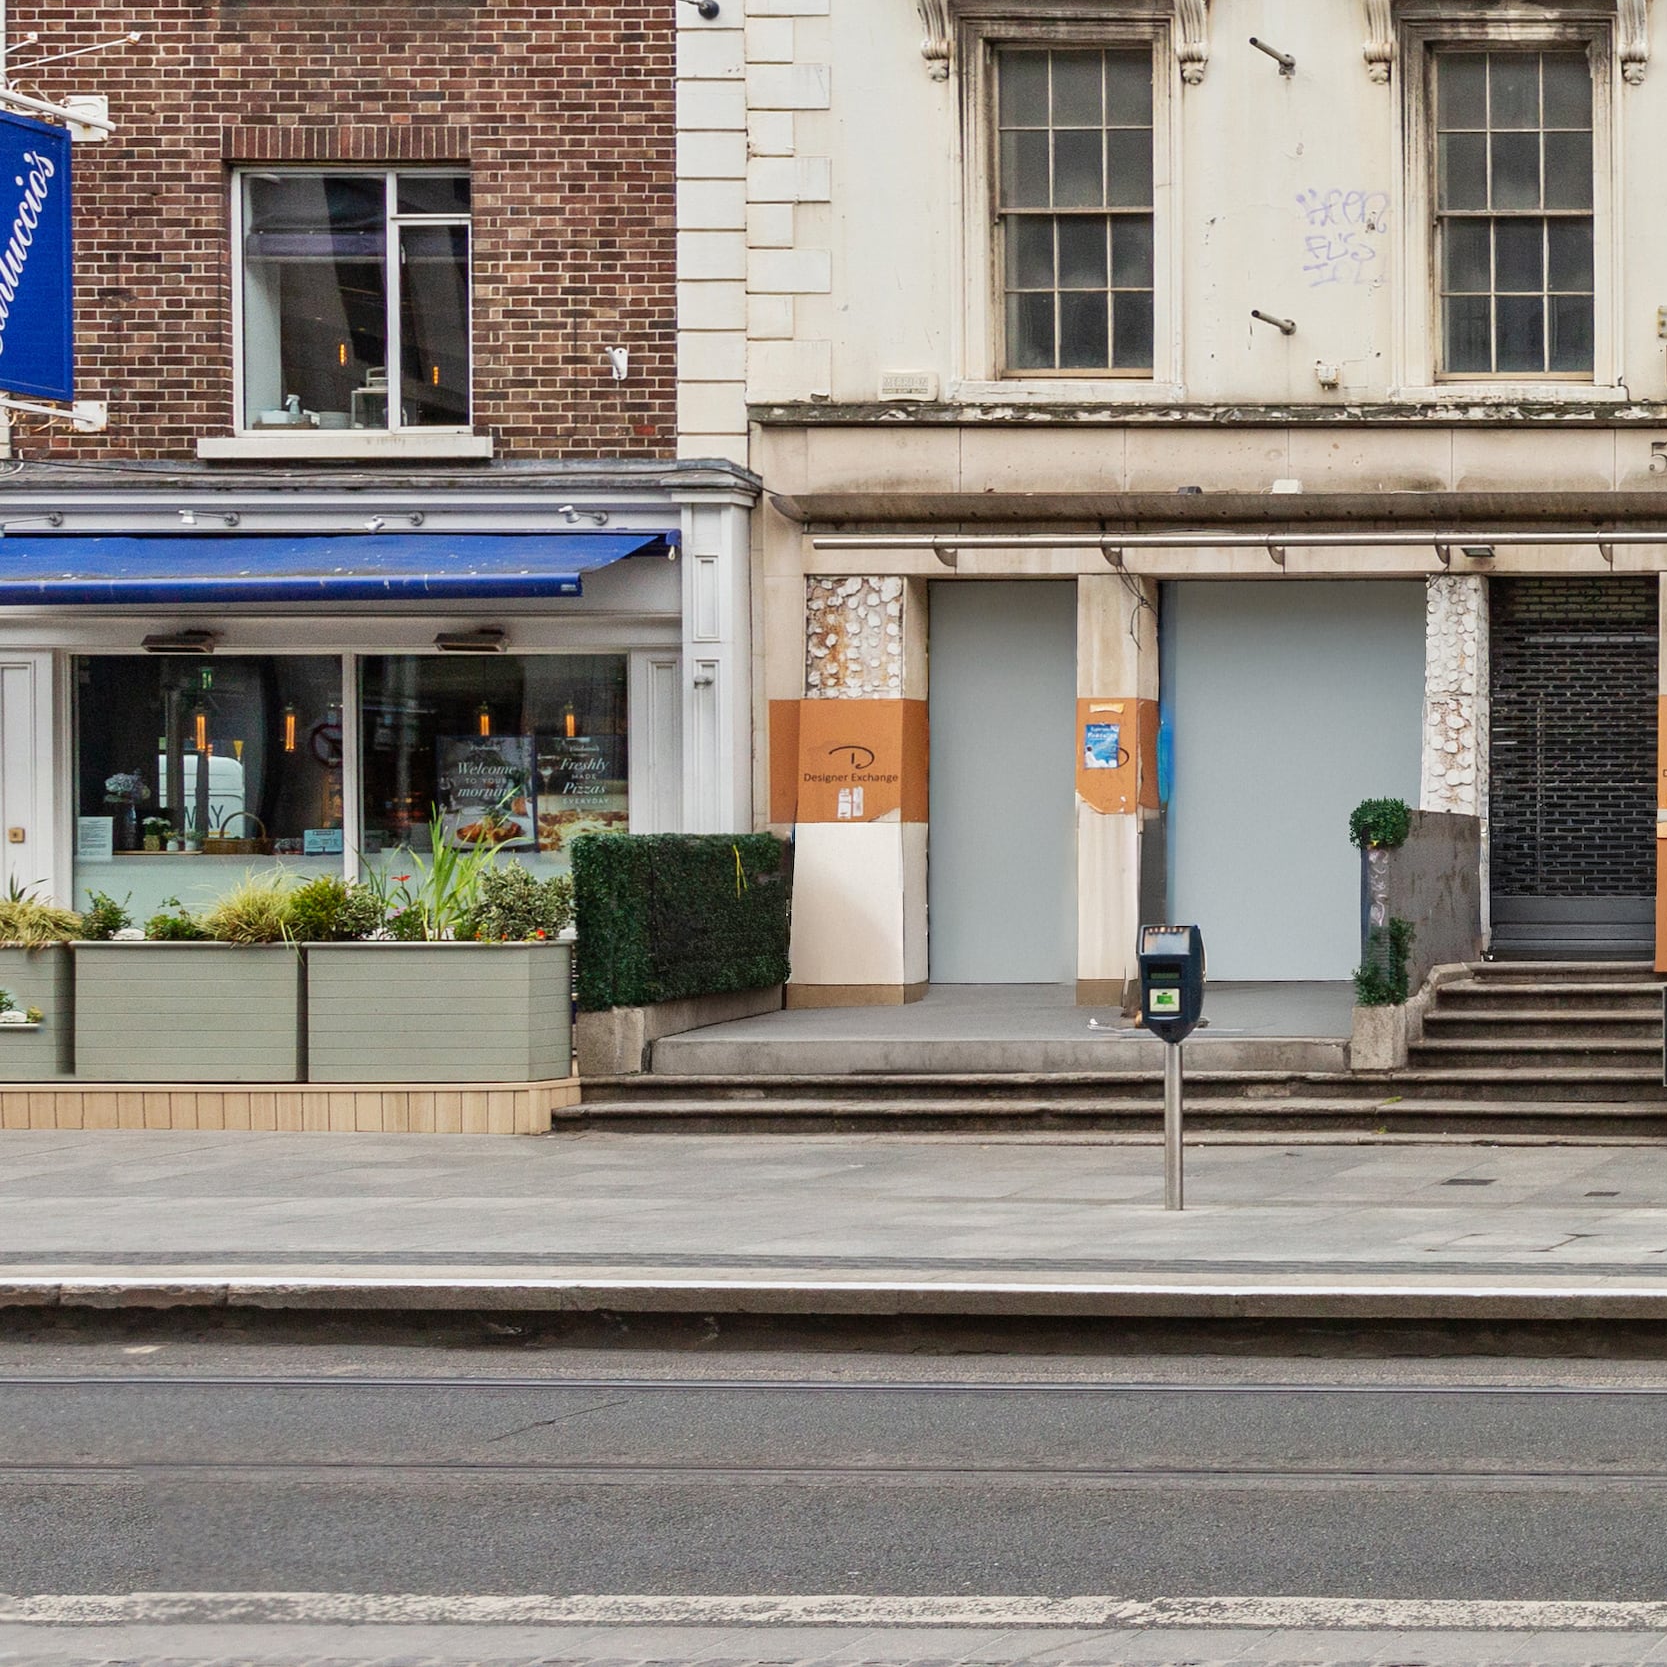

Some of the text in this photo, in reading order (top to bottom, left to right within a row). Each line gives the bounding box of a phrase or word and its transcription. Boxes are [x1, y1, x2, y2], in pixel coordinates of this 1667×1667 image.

[0, 149, 55, 355] rluccio's
[457, 761, 516, 776] Welcome
[560, 757, 609, 773] Freshly
[803, 772, 898, 784] Designer Exchange
[457, 786, 513, 800] mornin
[562, 782, 606, 796] Pizzas
[562, 797, 610, 805] EVERYDAY
